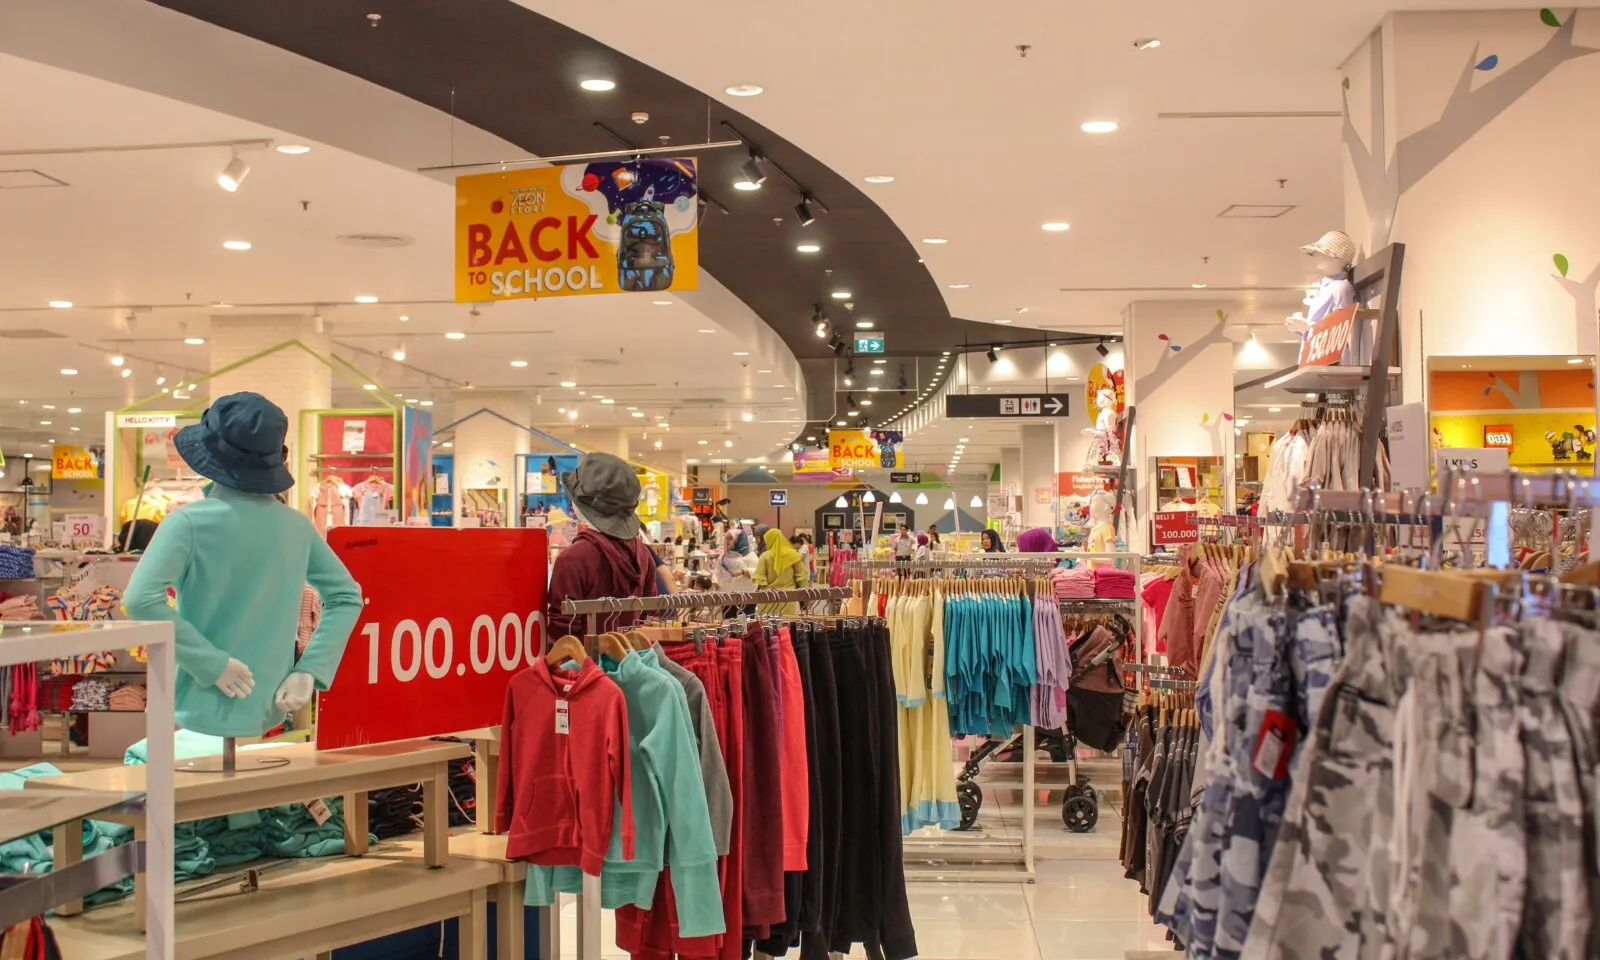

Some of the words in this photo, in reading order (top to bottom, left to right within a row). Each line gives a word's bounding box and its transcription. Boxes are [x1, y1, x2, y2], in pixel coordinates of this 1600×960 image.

[468, 214, 600, 267] BACK
[468, 271, 487, 285] TO
[490, 265, 604, 295] SCHOOL
[148, 416, 170, 424] KITTY
[833, 445, 875, 458] BACK
[56, 457, 93, 470] BACK
[840, 459, 876, 467] SCHOOL
[64, 470, 94, 478] SCHOOL
[1162, 530, 1197, 538] 100.000
[360, 610, 549, 684] 100.000
